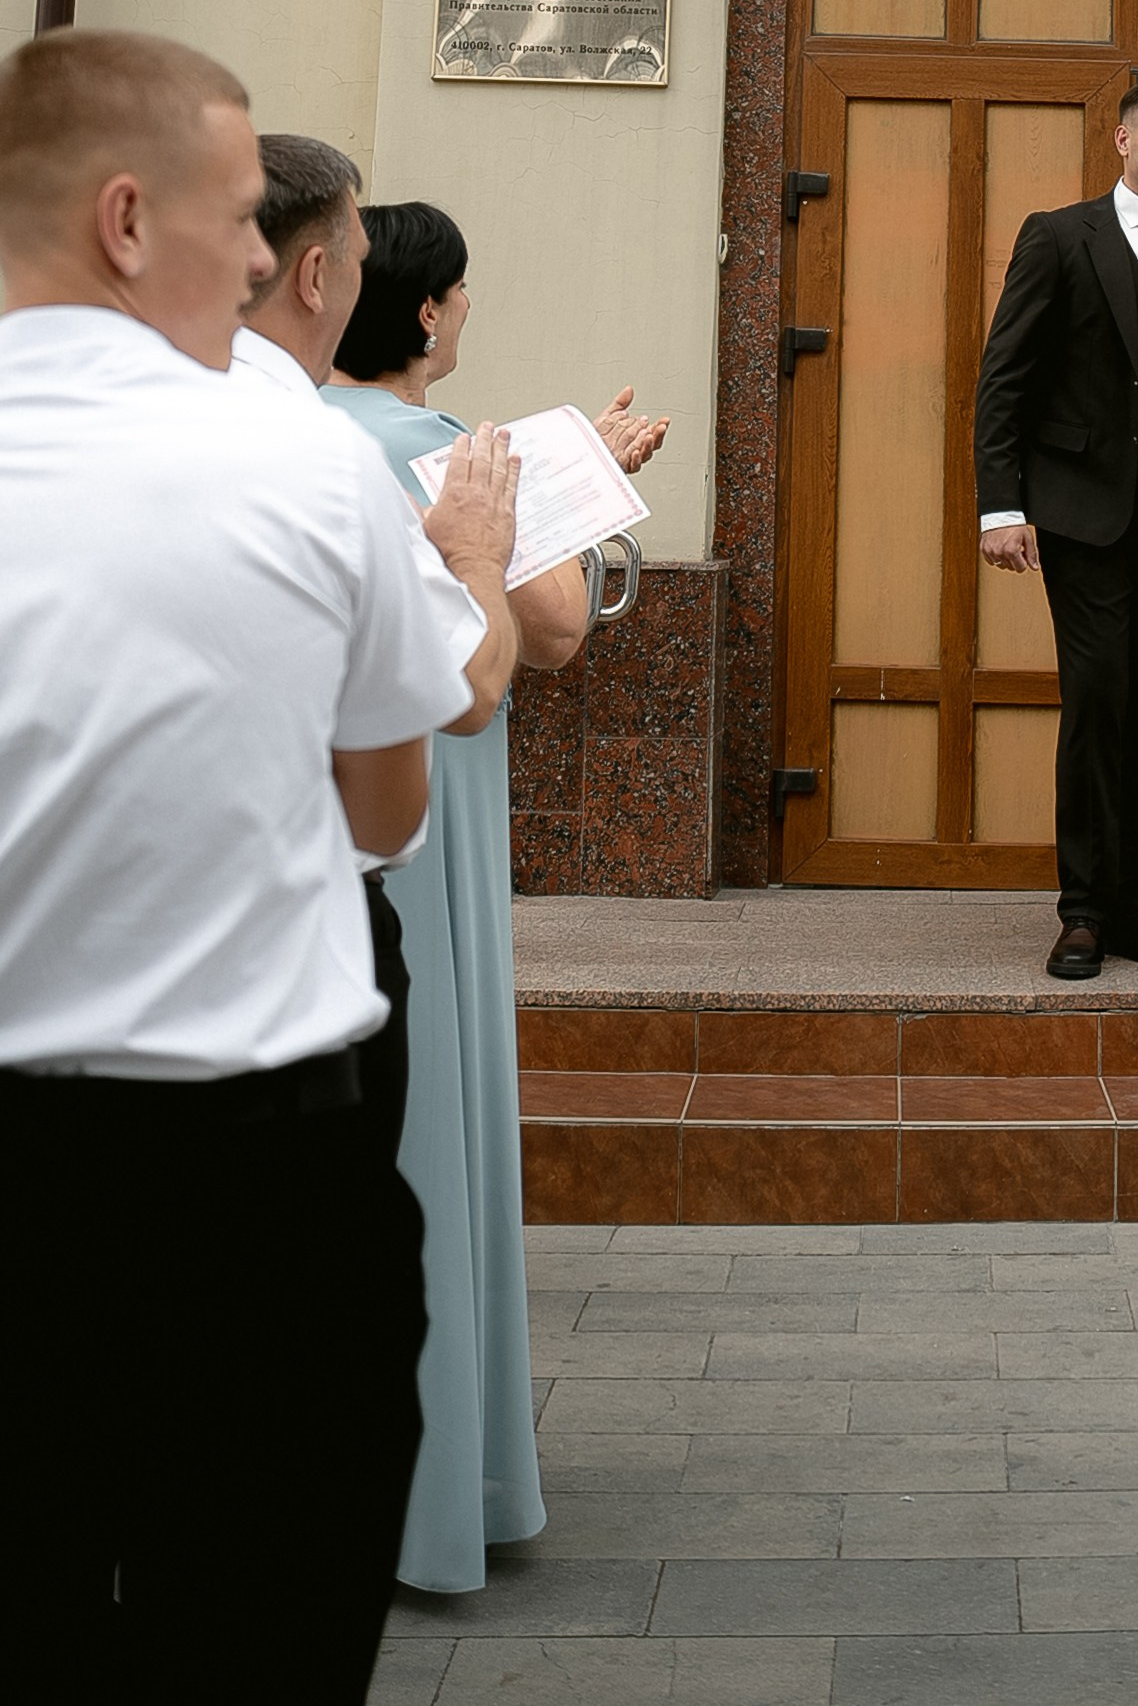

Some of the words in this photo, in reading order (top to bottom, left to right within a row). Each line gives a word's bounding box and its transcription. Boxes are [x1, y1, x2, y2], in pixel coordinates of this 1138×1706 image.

[449, 0, 533, 12] Правительства
[537, 3, 610, 14] Саратовской
[613, 5, 658, 15] области
[451, 41, 493, 52] 410002,
[508, 42, 556, 54] Саратов,
[560, 45, 575, 55] ул.
[580, 44, 637, 56] Волжская,
[640, 46, 653, 54] 22
